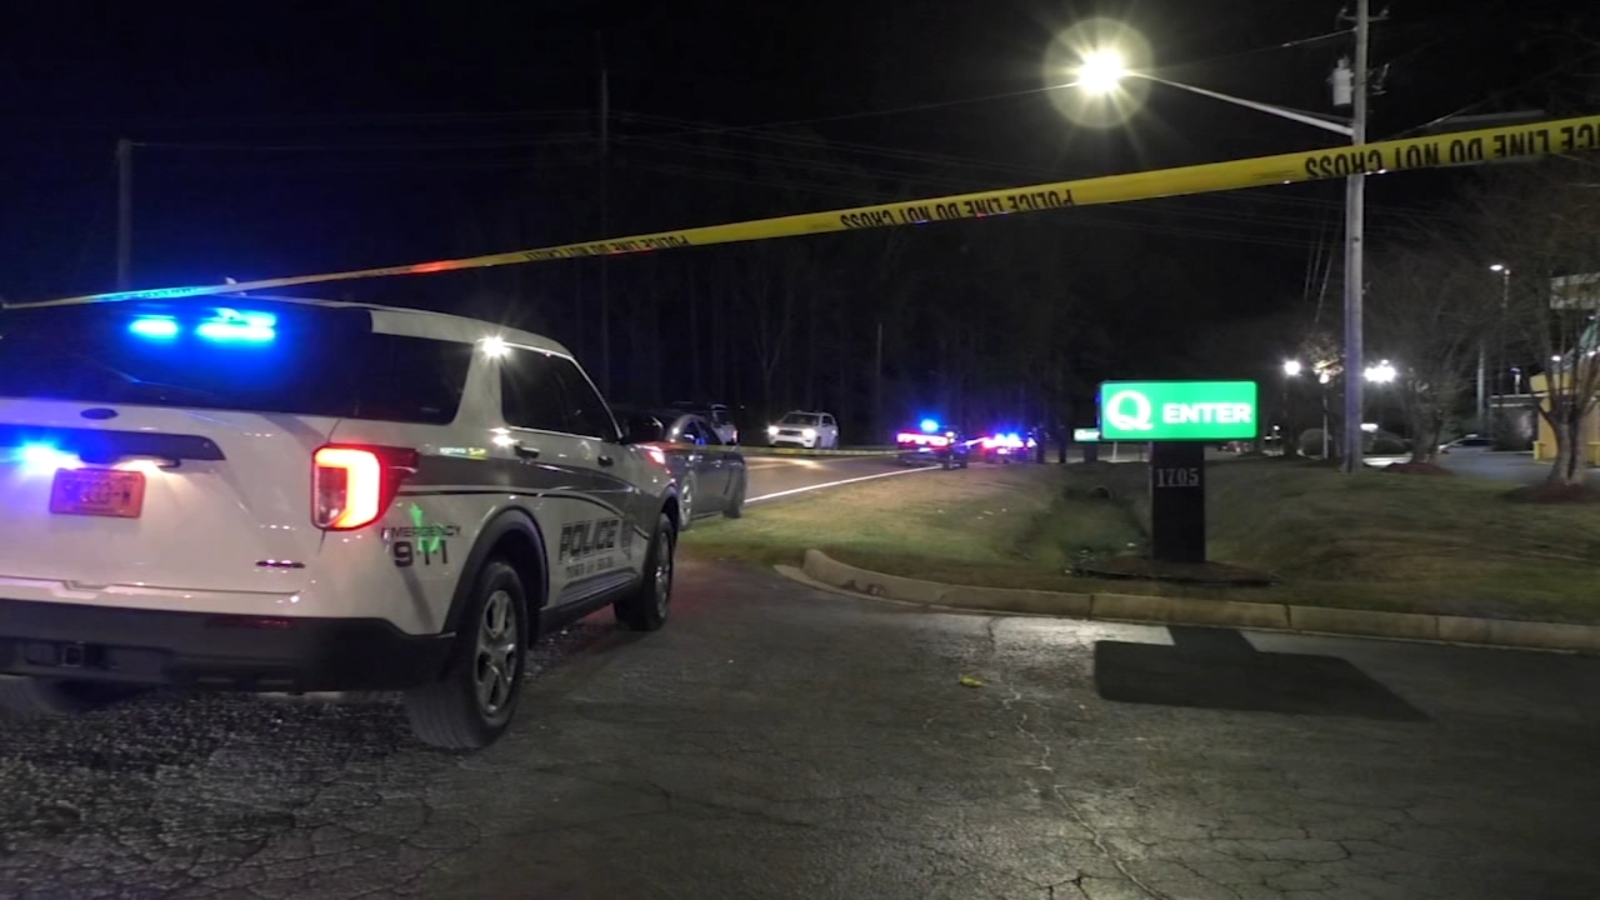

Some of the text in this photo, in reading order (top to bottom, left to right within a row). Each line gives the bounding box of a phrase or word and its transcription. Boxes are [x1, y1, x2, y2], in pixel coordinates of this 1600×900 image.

[1395, 142, 1440, 168] NOT
[1451, 138, 1483, 162] DO
[1494, 129, 1549, 158] LINE
[1305, 149, 1383, 179] CROSS
[840, 189, 1075, 229] POLICE LINE DO NOT CROSS
[1106, 390, 1253, 430] Q ENTER
[1156, 468, 1200, 487] 1705
[394, 540, 448, 568] 911
[559, 519, 620, 561] POLICE
